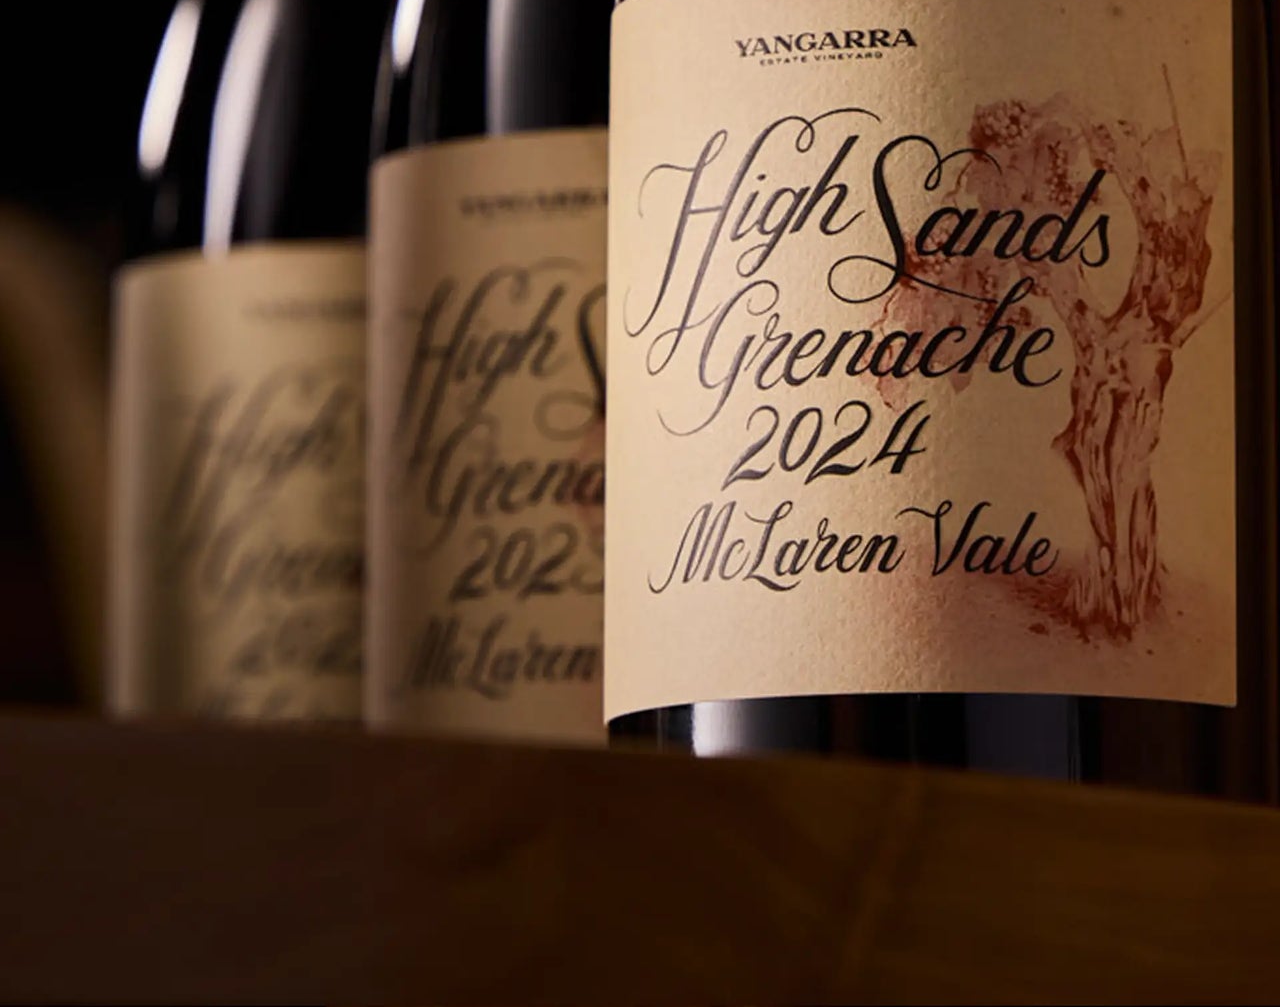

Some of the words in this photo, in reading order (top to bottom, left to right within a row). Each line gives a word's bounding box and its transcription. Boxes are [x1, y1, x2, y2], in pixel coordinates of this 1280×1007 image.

[735, 28, 918, 58] YANGARRA
[759, 55, 808, 67] ESTATE
[814, 50, 883, 63] VINEYARD
[625, 107, 881, 375] High
[827, 135, 1111, 303] Sands
[388, 256, 585, 477] High
[657, 278, 1063, 436] Grenache
[404, 412, 606, 559] Grena
[721, 399, 931, 490] 2024
[648, 499, 905, 594] McLaren
[896, 499, 1060, 577] Vale
